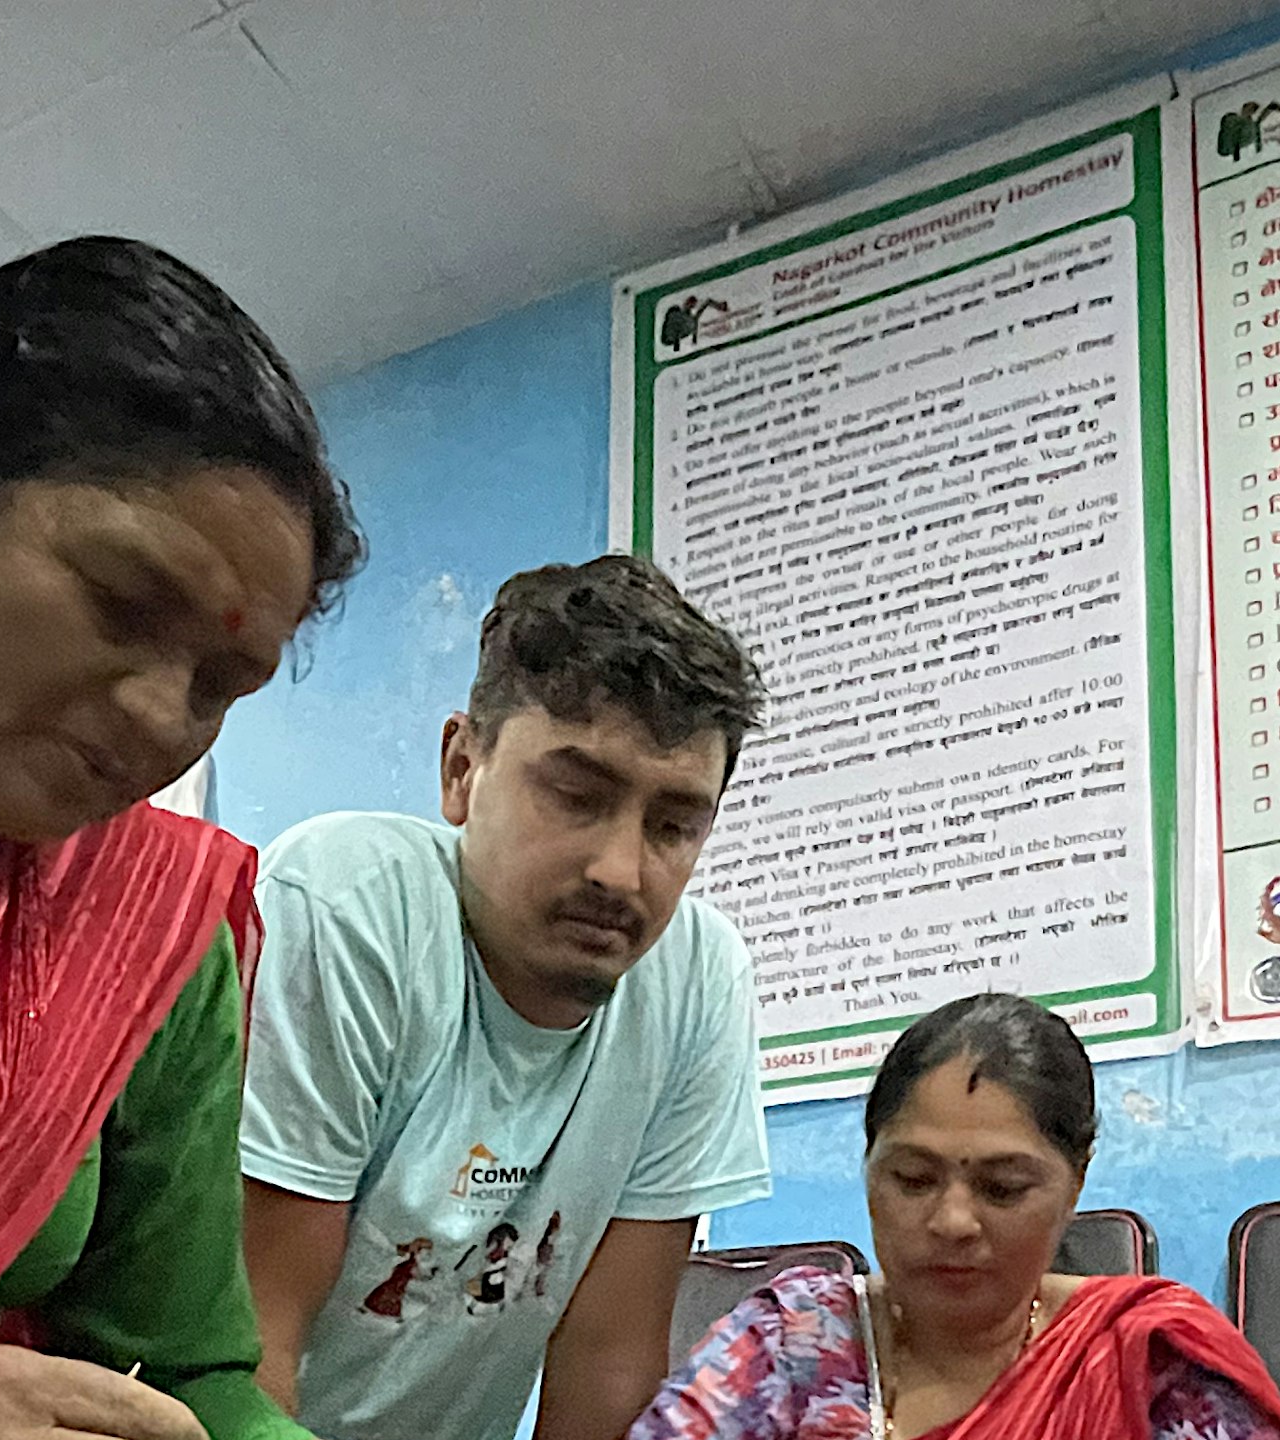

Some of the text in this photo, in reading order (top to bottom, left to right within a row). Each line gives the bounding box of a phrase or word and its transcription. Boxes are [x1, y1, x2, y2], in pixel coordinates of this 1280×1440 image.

[772, 149, 1124, 285] Nagarkot Community Homestay
[964, 531, 1038, 561] household
[965, 590, 1058, 624] psychotropic
[1061, 577, 1102, 597] drugs
[1039, 686, 1074, 705] after
[775, 825, 801, 841] will
[805, 821, 832, 836] rely
[858, 806, 893, 824] valid
[897, 803, 927, 817] visa
[770, 883, 826, 903] drinking
[852, 862, 929, 887] completely
[932, 845, 1006, 876] prohibited
[1053, 826, 1127, 849] homestay
[805, 935, 871, 957] forbidden
[962, 910, 998, 928] work
[1007, 905, 1035, 920] that
[1044, 897, 1095, 915] affects
[843, 993, 885, 1013] Thank
[759, 1050, 816, 1071] 350425
